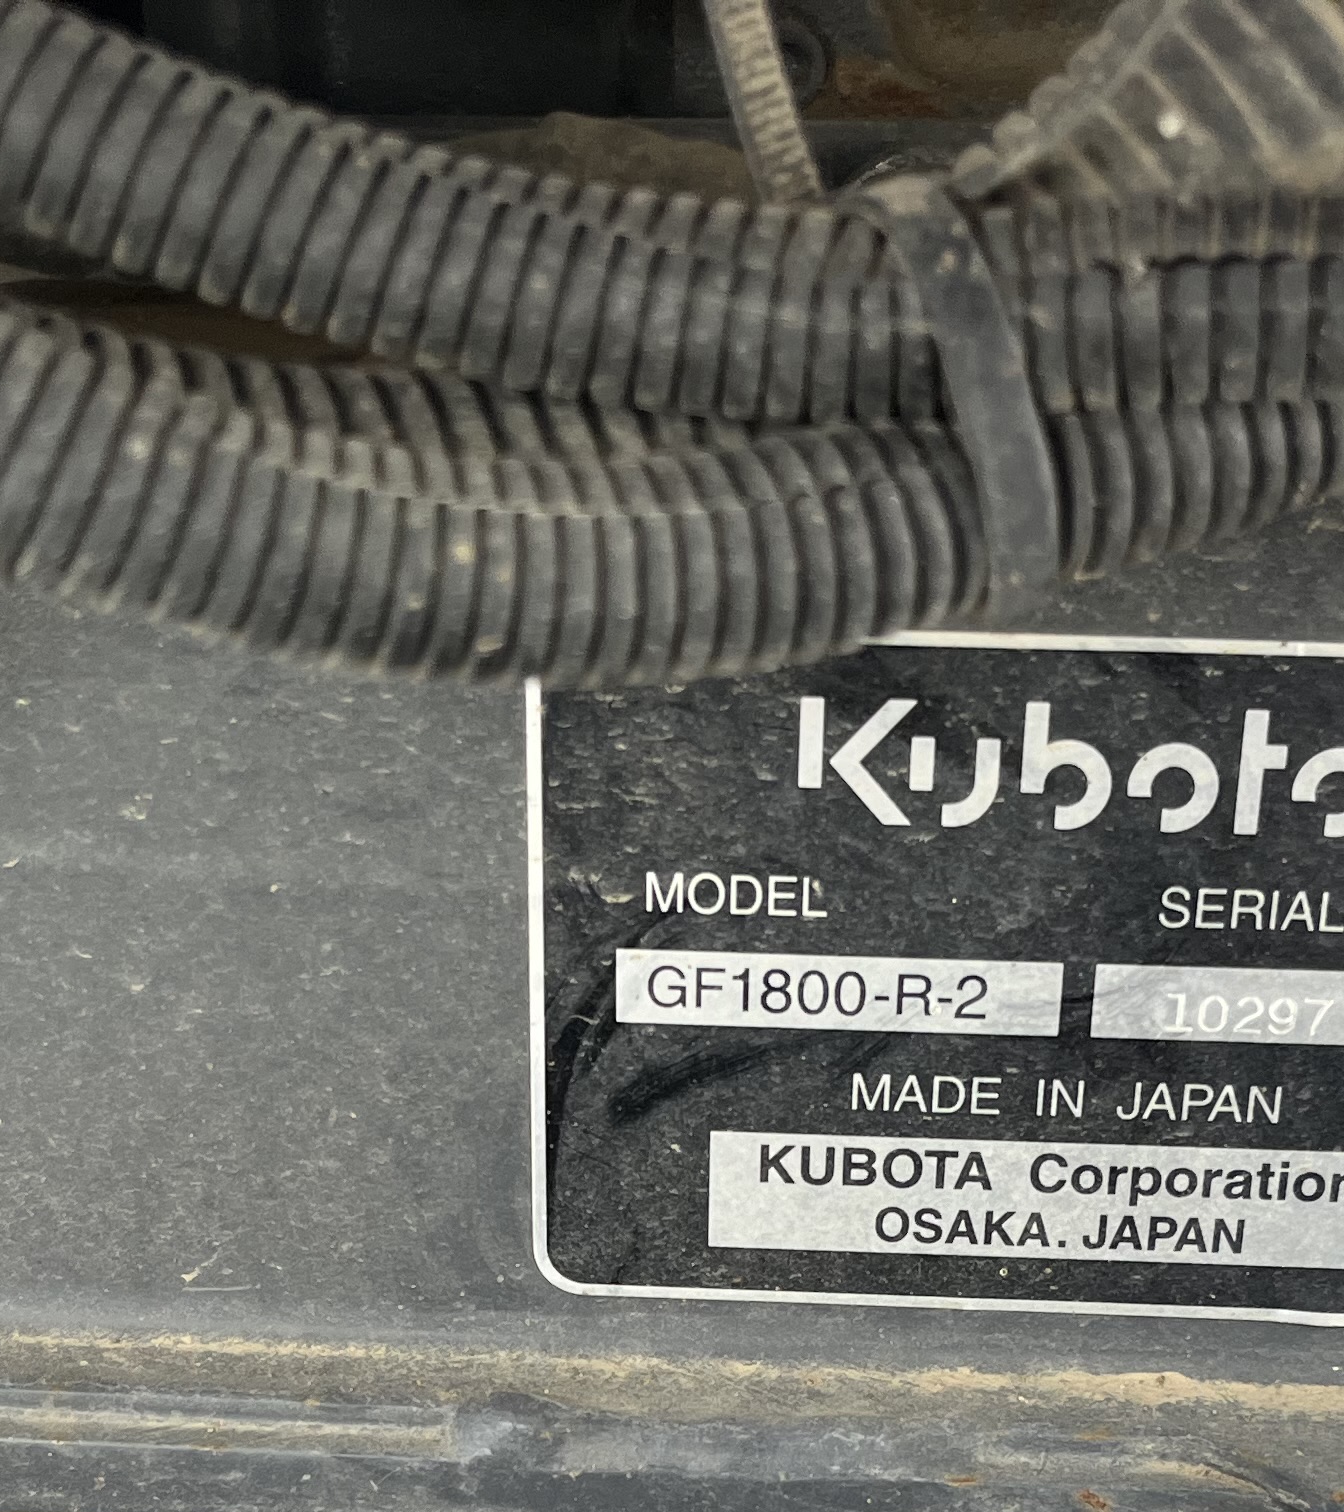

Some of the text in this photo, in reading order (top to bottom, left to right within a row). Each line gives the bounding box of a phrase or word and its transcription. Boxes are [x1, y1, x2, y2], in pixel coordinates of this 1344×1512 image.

[645, 871, 828, 918] MODEL
[1158, 886, 1344, 933] SERIAL
[645, 964, 990, 1022] GF1800-R-2
[1160, 991, 1336, 1037] 10297
[851, 1072, 1283, 1124] MADE IN JAPAN
[759, 1144, 993, 1191] KUBOTA
[1082, 1214, 1246, 1254] JAPAN
